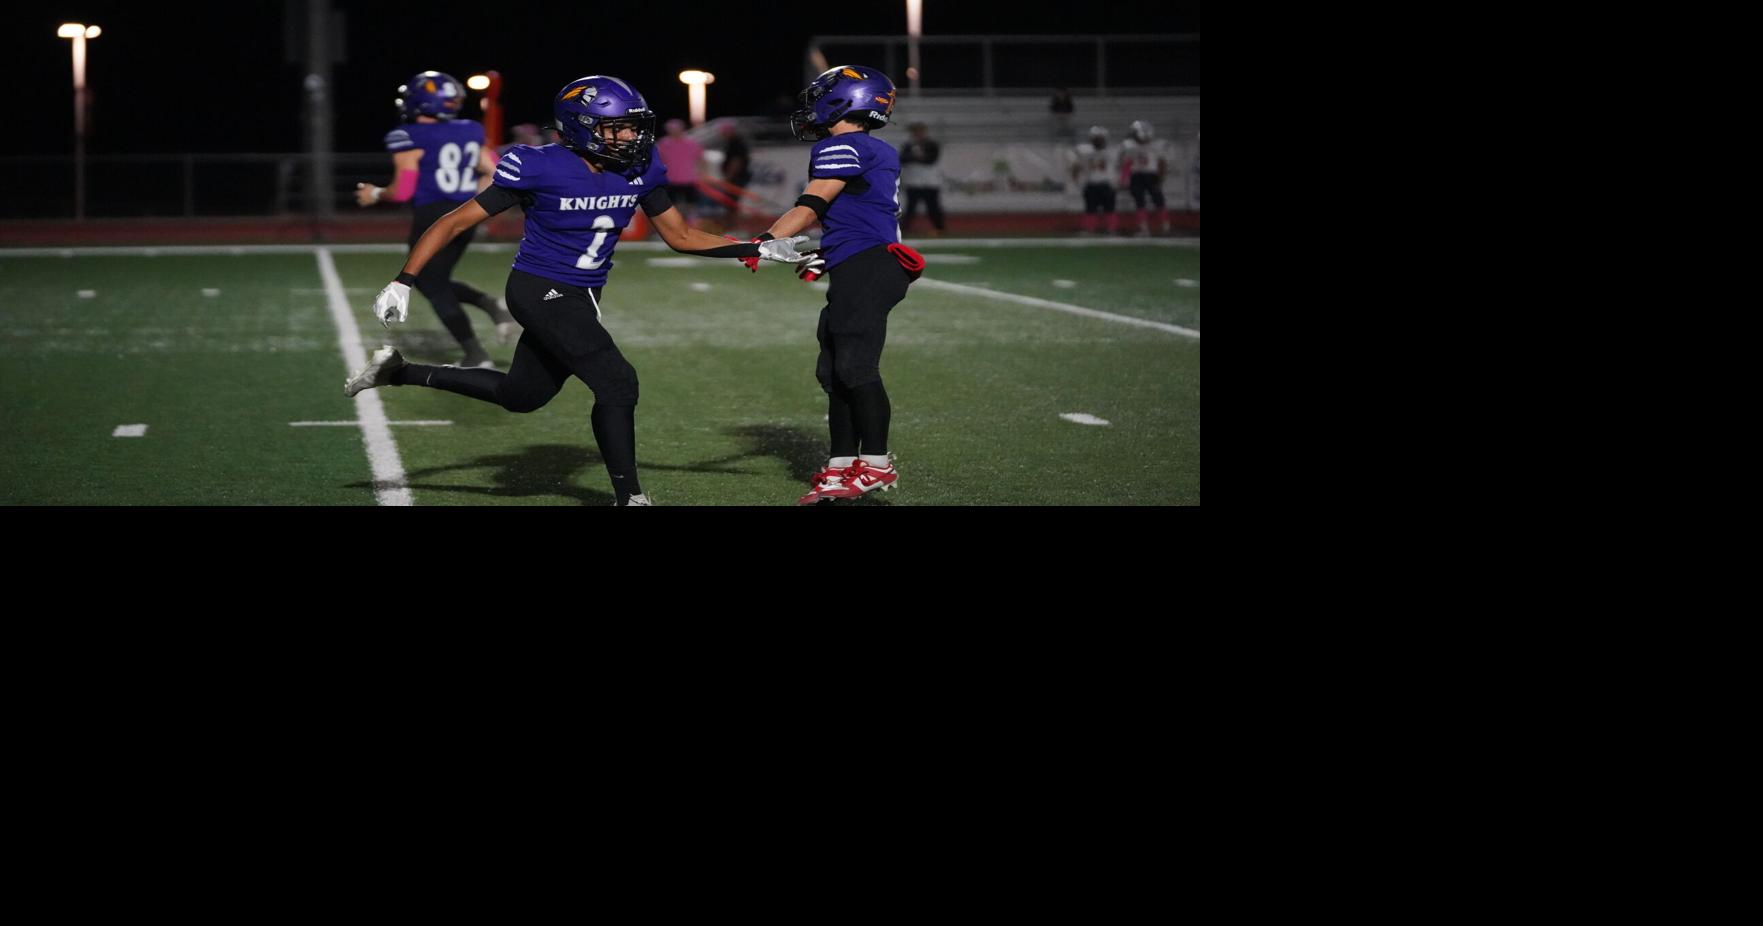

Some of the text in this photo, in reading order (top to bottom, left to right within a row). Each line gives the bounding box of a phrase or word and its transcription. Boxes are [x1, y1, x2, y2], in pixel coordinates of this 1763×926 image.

[434, 141, 480, 193] 82
[559, 194, 639, 211] KNIGHTS
[575, 214, 616, 270] 2
